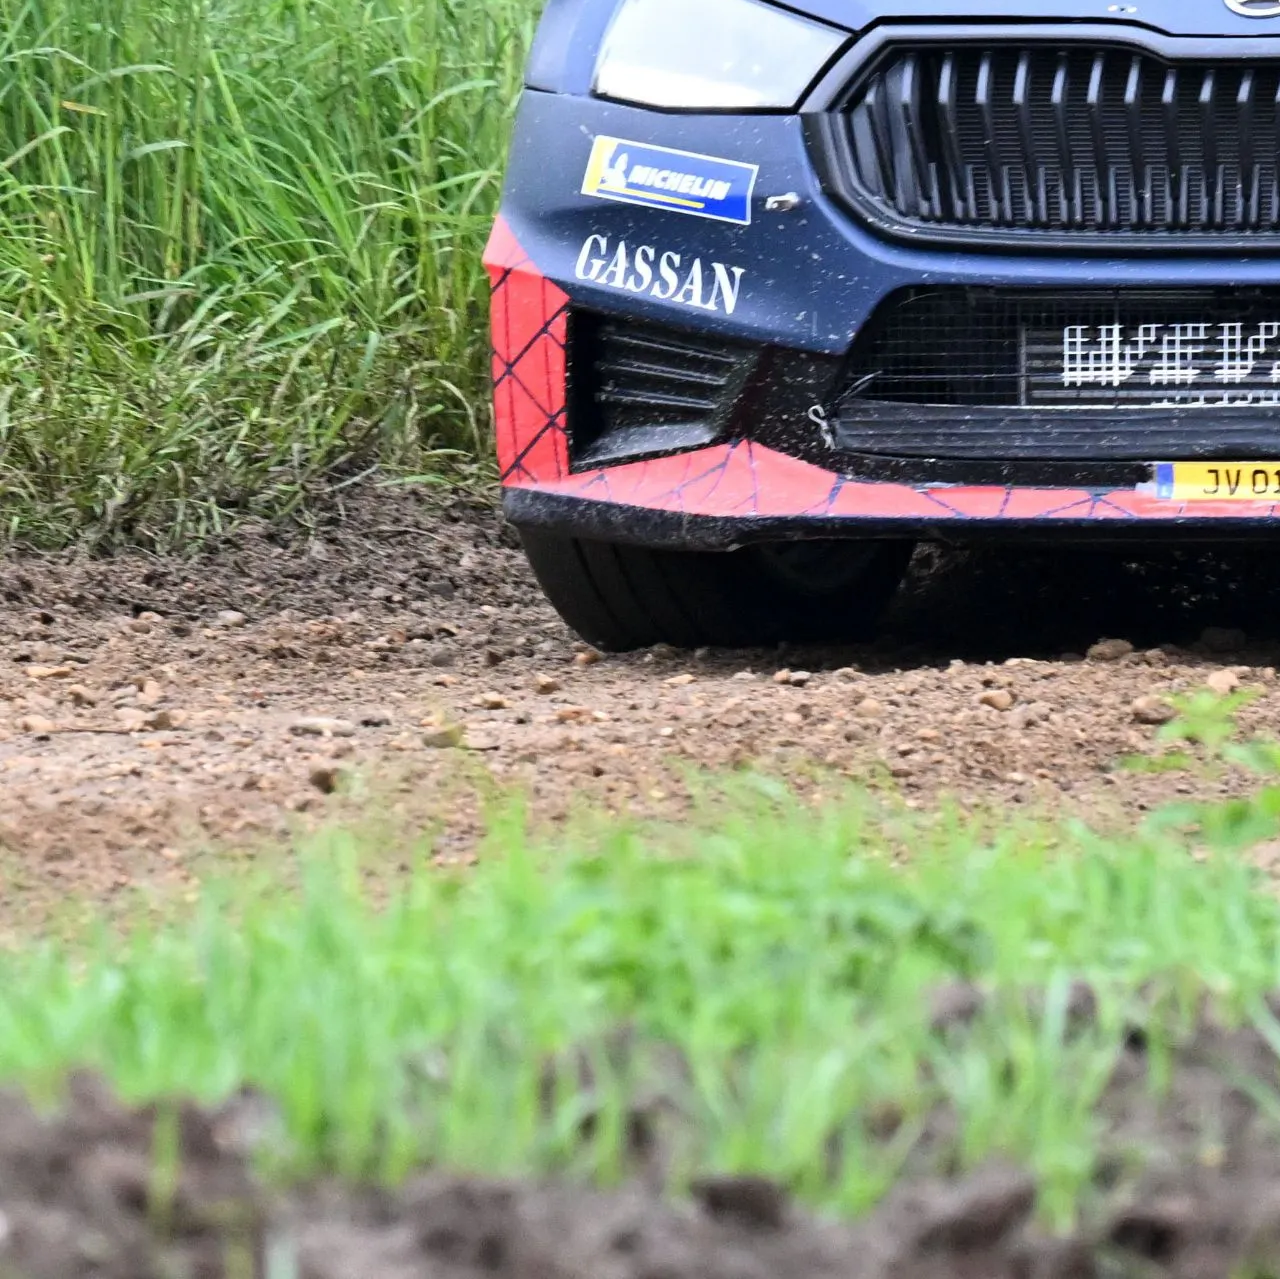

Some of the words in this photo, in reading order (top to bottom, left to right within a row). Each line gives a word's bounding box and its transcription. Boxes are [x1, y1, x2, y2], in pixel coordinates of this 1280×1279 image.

[627, 165, 732, 201] MICHELIN
[575, 234, 746, 315] GASSAN
[1203, 469, 1241, 496] JV
